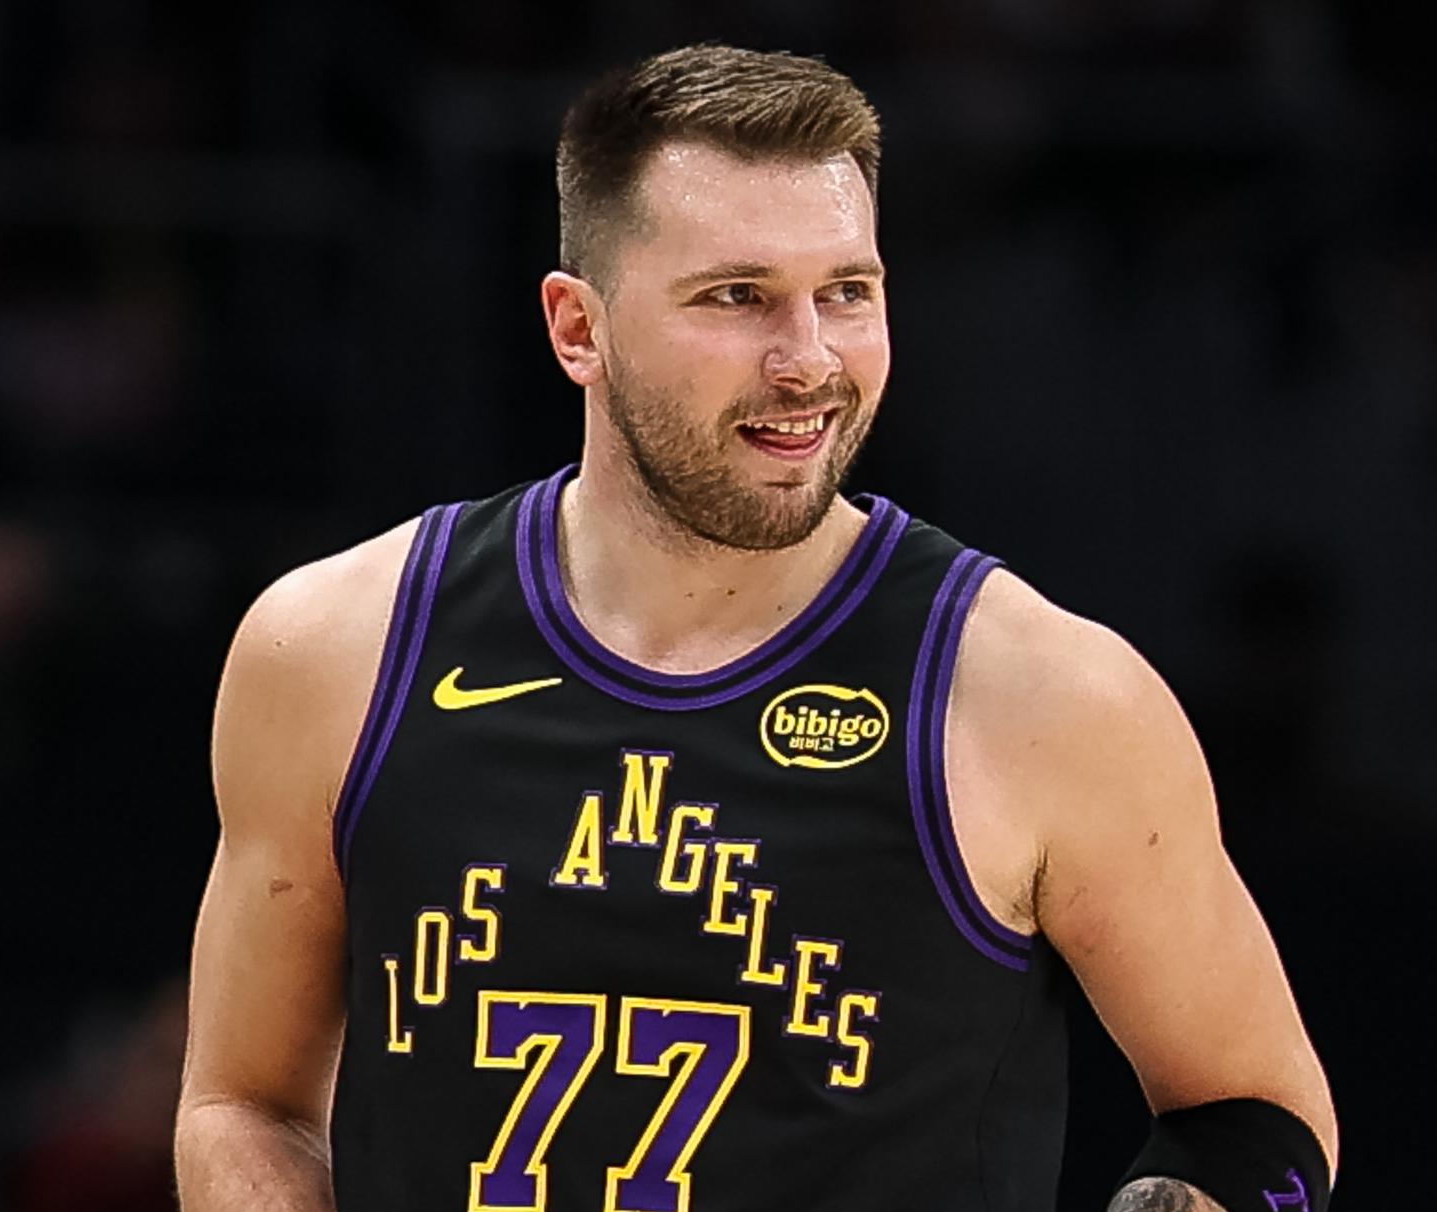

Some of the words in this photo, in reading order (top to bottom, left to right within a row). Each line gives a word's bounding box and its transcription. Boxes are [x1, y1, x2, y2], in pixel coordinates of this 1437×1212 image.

[773, 705, 882, 747] bibigo
[382, 863, 508, 1056] LOS
[550, 748, 882, 1089] ANGELES
